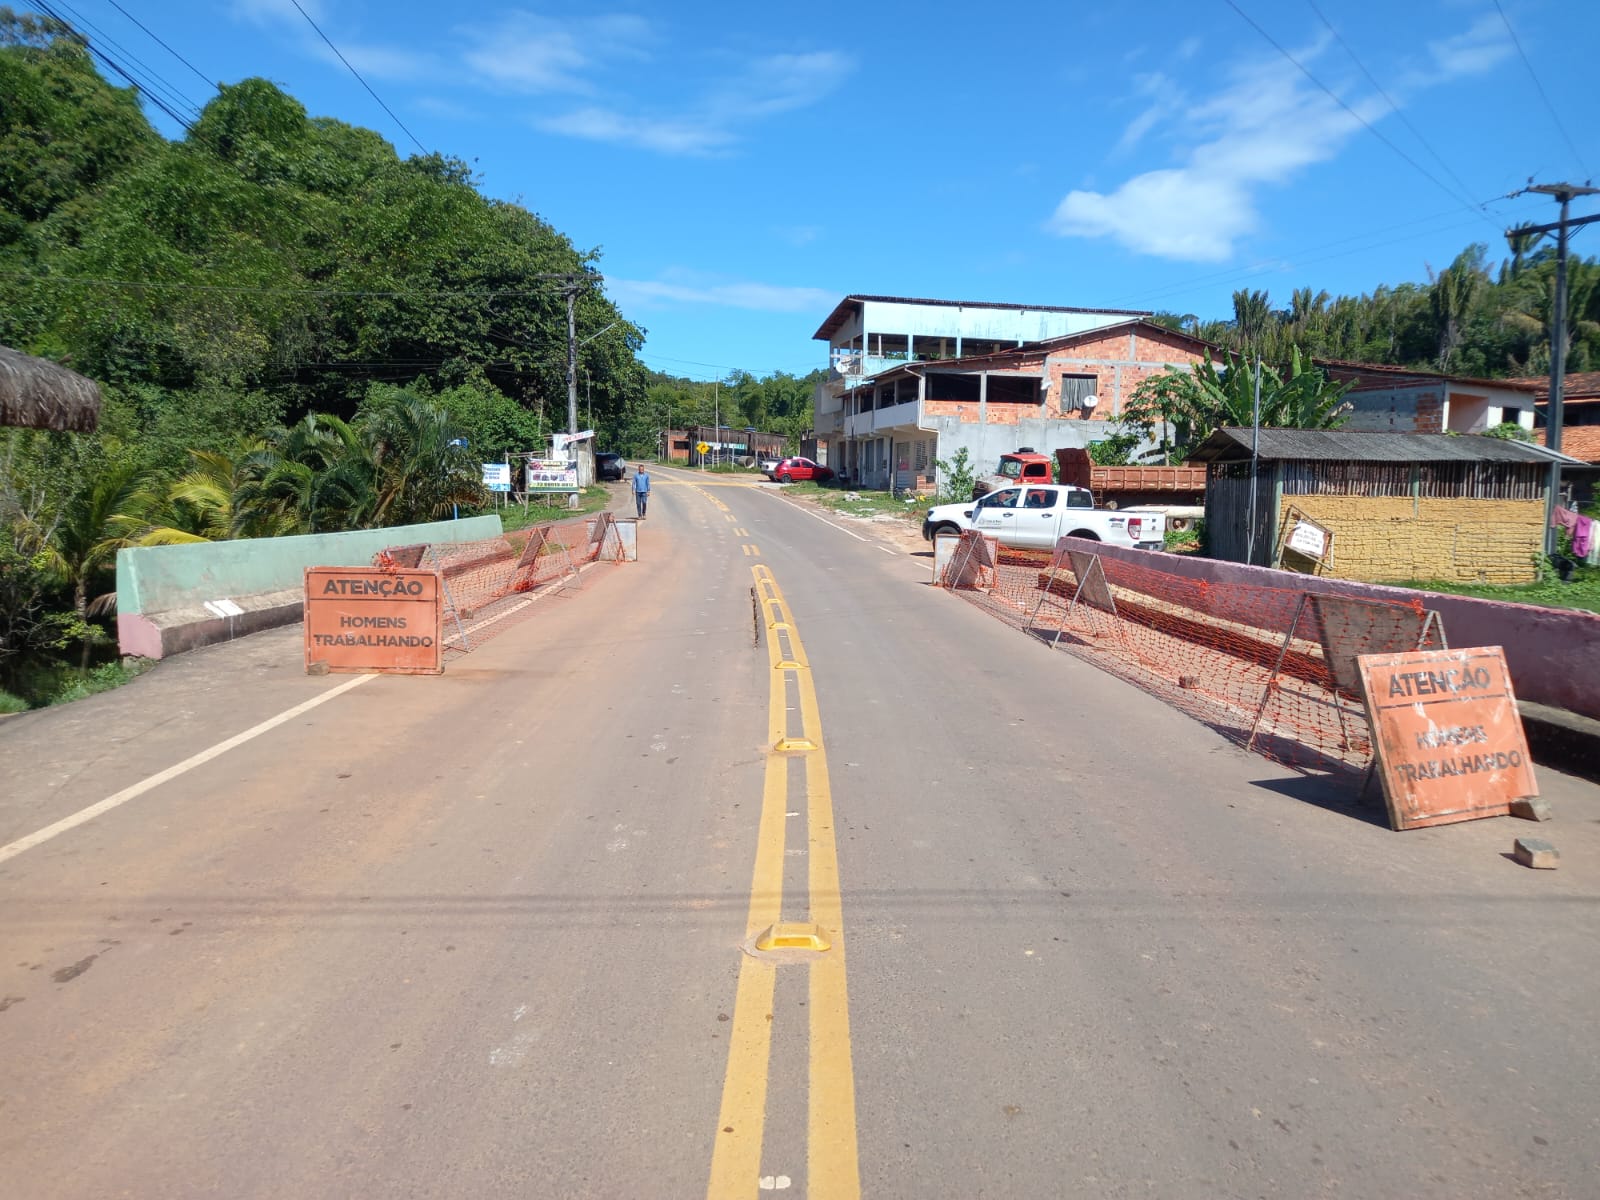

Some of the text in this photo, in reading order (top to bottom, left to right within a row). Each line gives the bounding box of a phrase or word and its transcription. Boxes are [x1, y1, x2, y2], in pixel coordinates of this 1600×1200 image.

[323, 576, 423, 597] ATENÇÃO
[340, 616, 407, 629] HOMENS
[313, 634, 433, 648] TRABALHANDO
